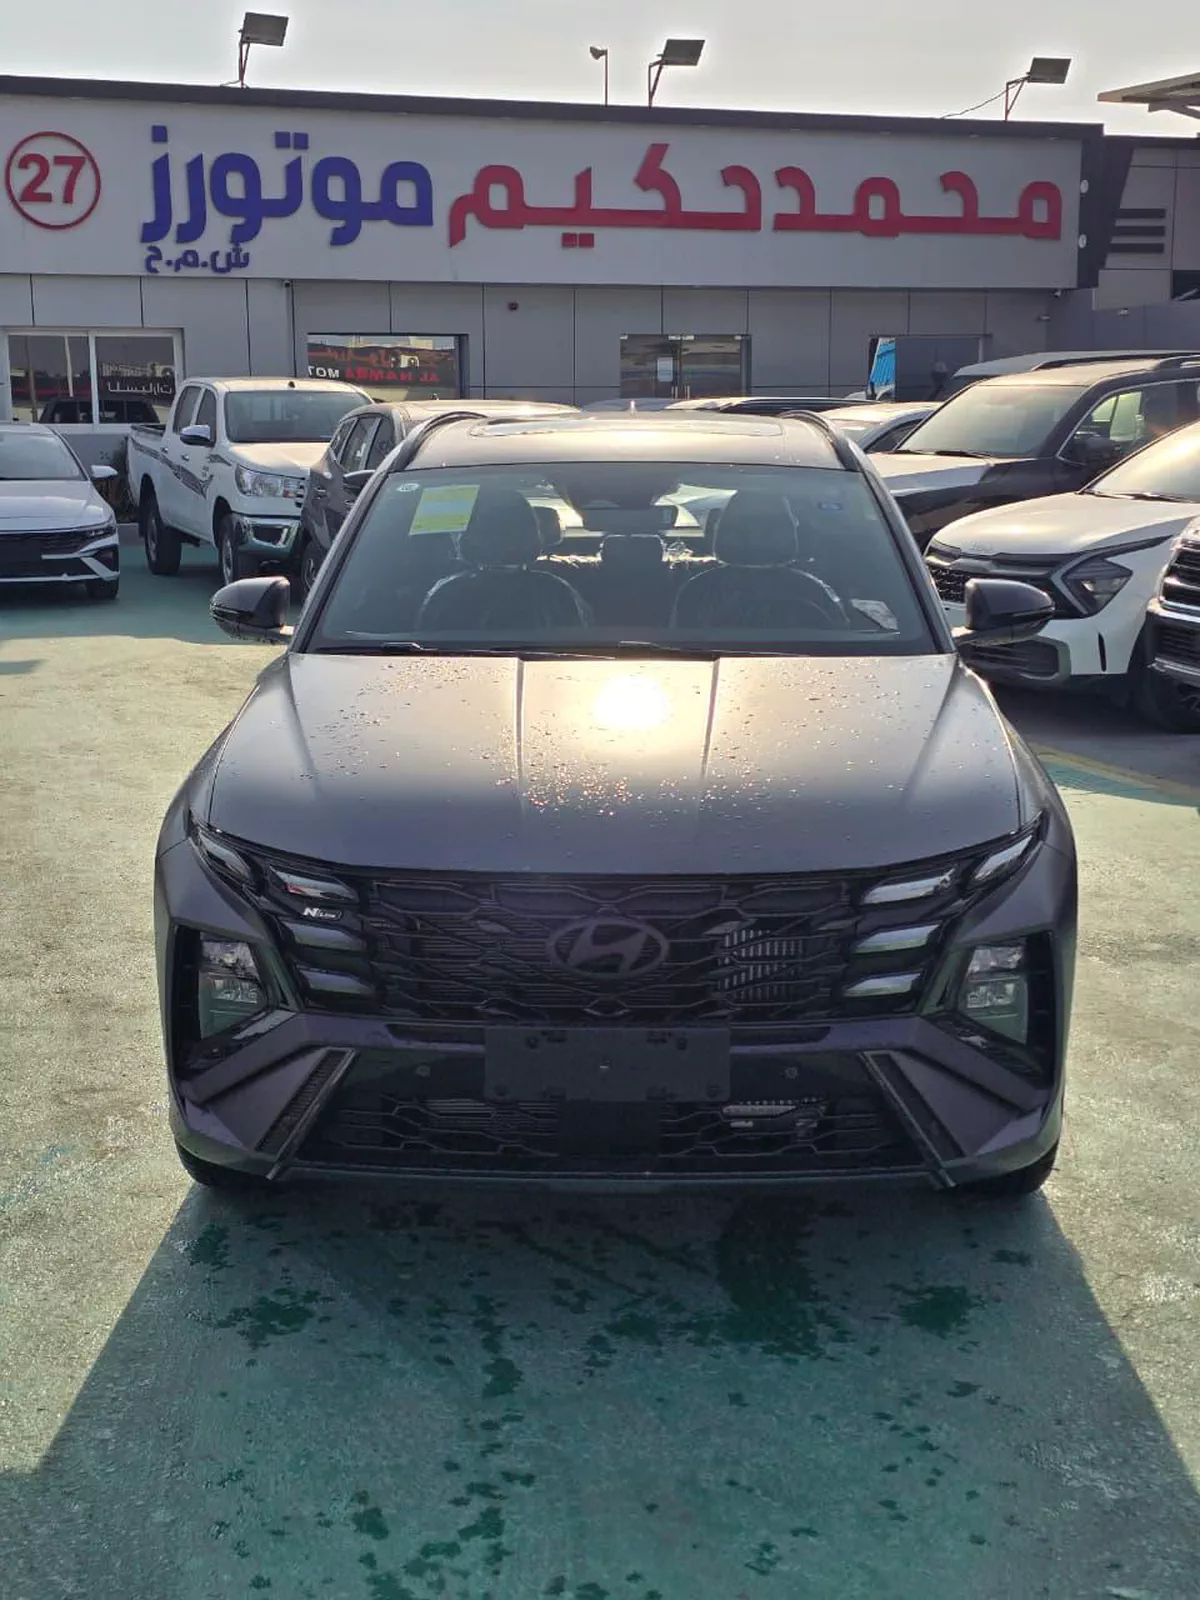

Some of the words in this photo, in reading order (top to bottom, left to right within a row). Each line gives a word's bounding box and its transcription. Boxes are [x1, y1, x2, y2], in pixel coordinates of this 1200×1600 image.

[17, 154, 86, 204] 27
[141, 125, 433, 246] موتورز
[449, 142, 762, 248] حكيم
[772, 166, 1062, 240] محمد
